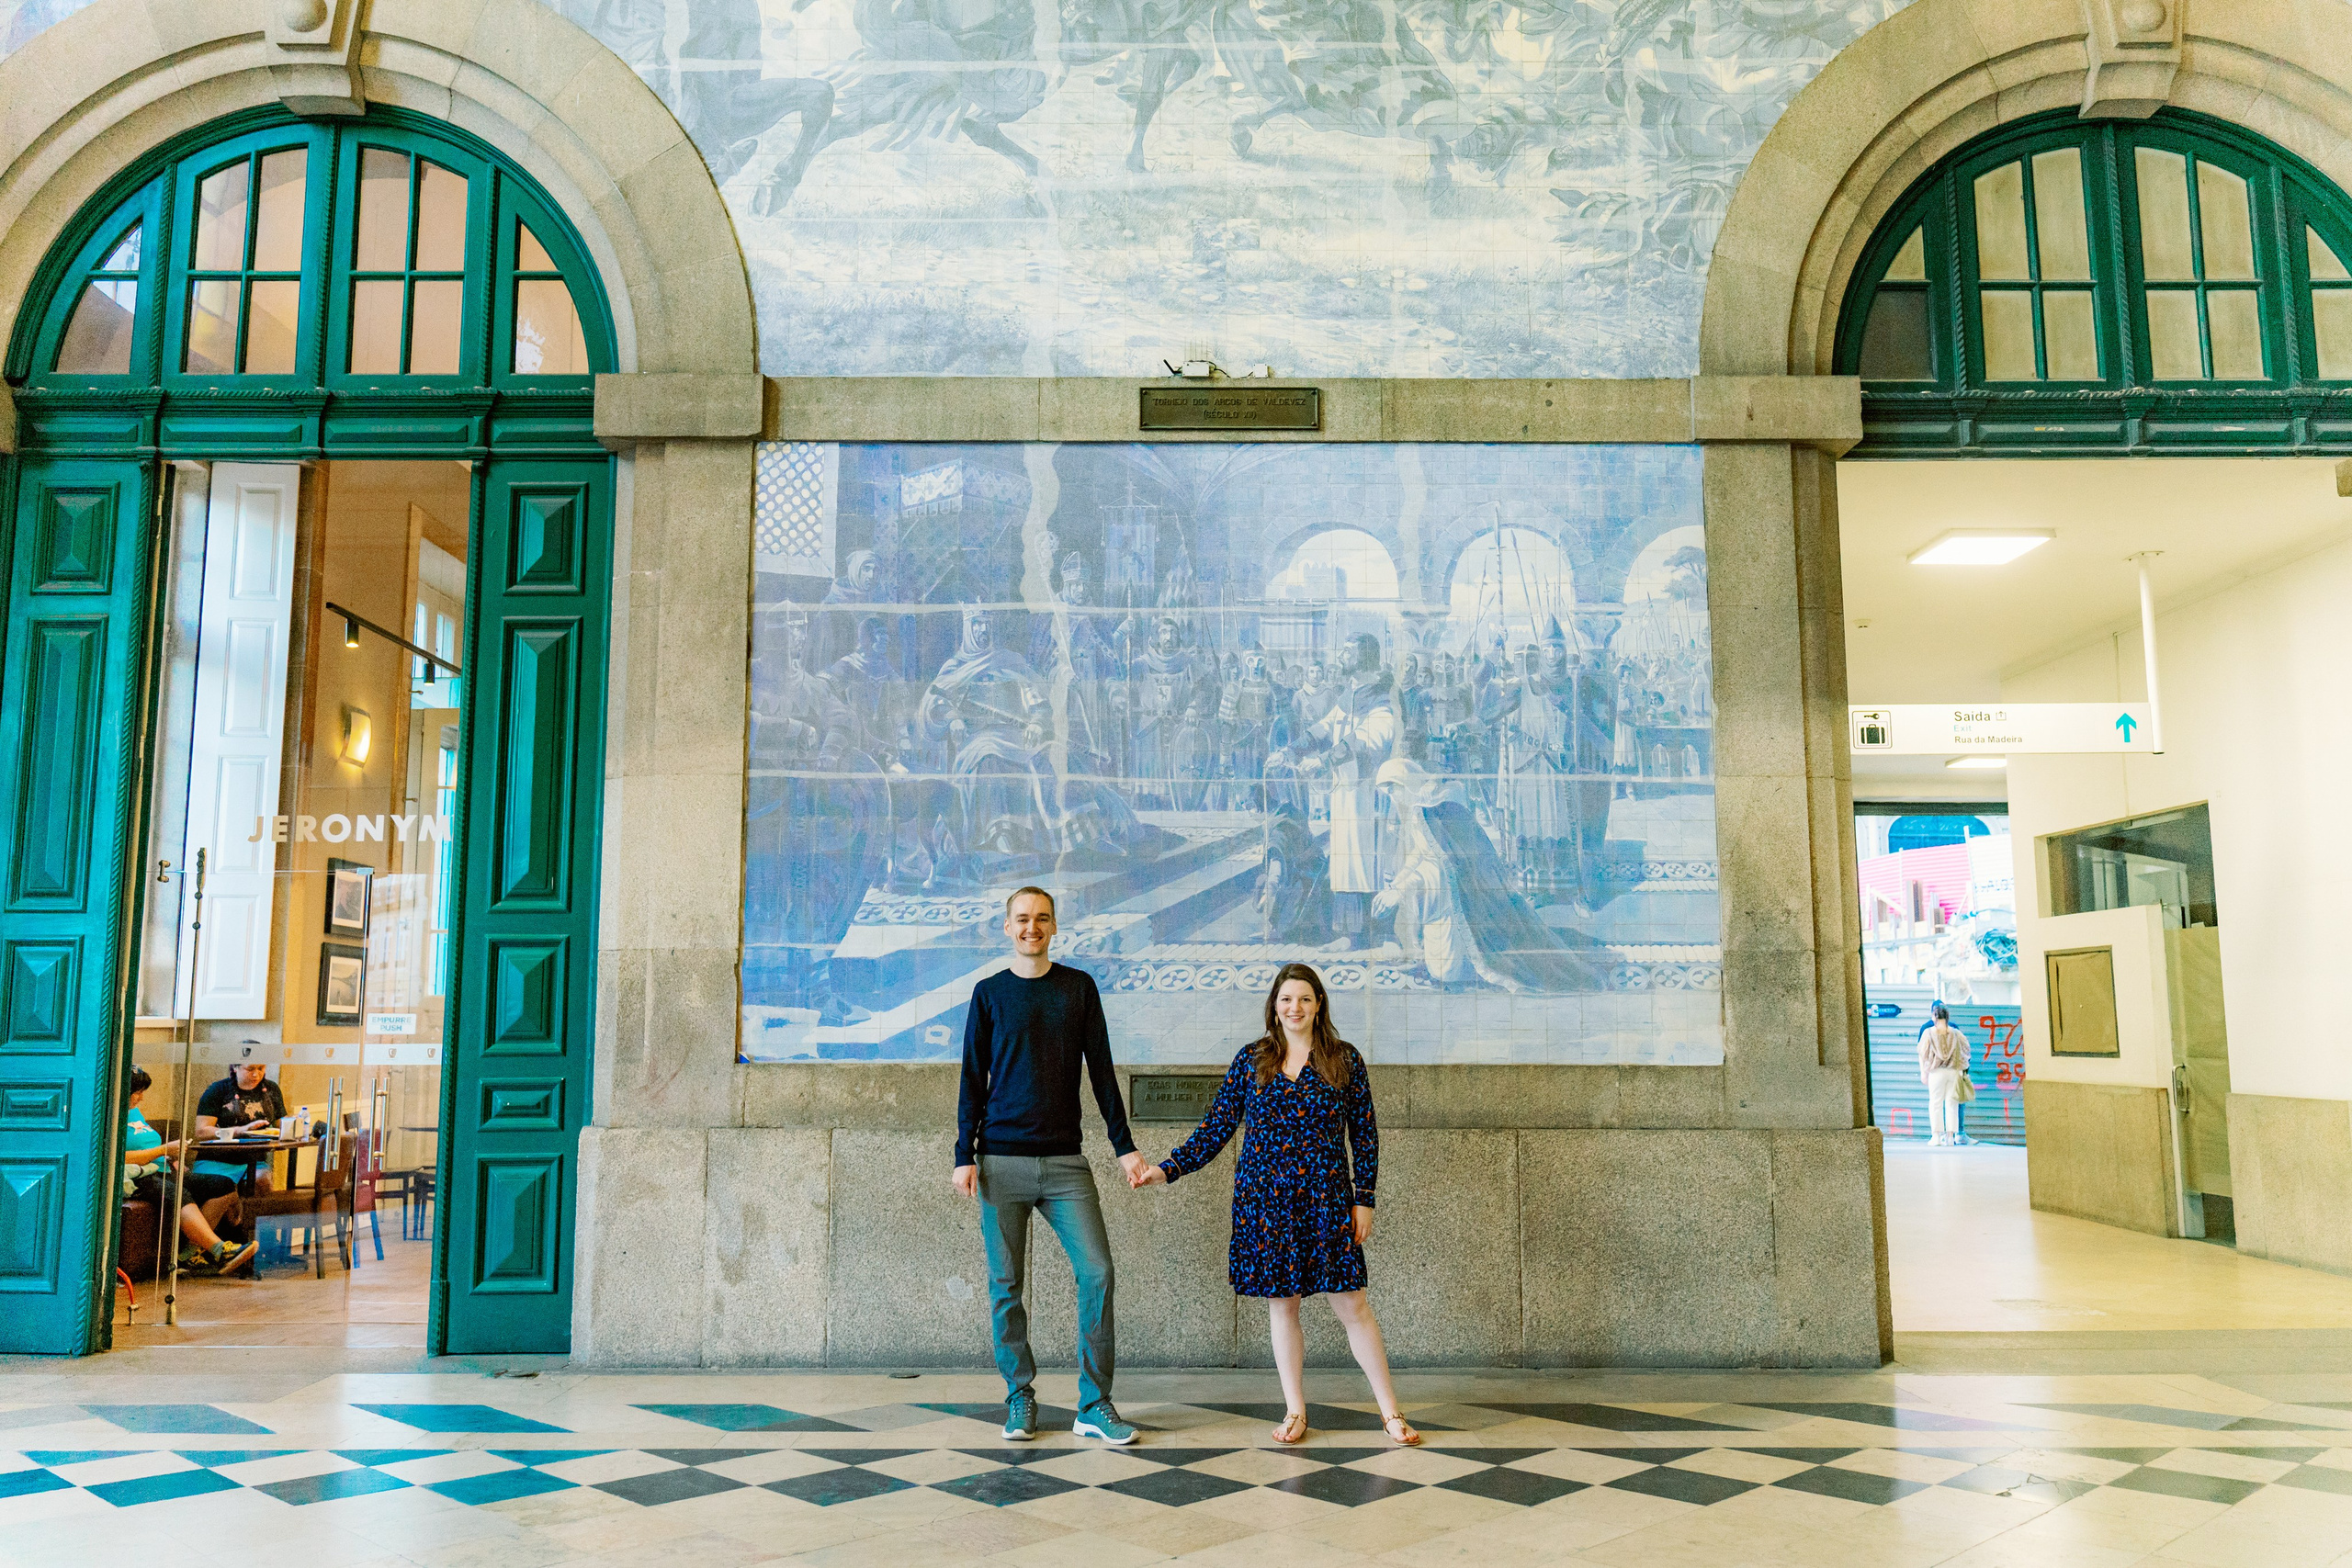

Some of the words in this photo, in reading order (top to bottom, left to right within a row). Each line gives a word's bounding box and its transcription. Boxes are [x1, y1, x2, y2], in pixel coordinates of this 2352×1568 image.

[1152, 397, 1188, 406] TORNEIO
[1192, 397, 1209, 406] DOS
[1214, 397, 1241, 406] ARCOS
[1246, 397, 1259, 406] DE
[1262, 397, 1306, 406] VALDEVEZ
[1953, 724, 1972, 732] Exit
[1987, 735, 2023, 743] Madeira
[1148, 1080, 1171, 1090] EGAS
[1176, 1080, 1203, 1090] MONIZ
[1144, 1093, 1151, 1102] A
[1156, 1093, 1193, 1102] MULHER
[1193, 1093, 1204, 1102] E
